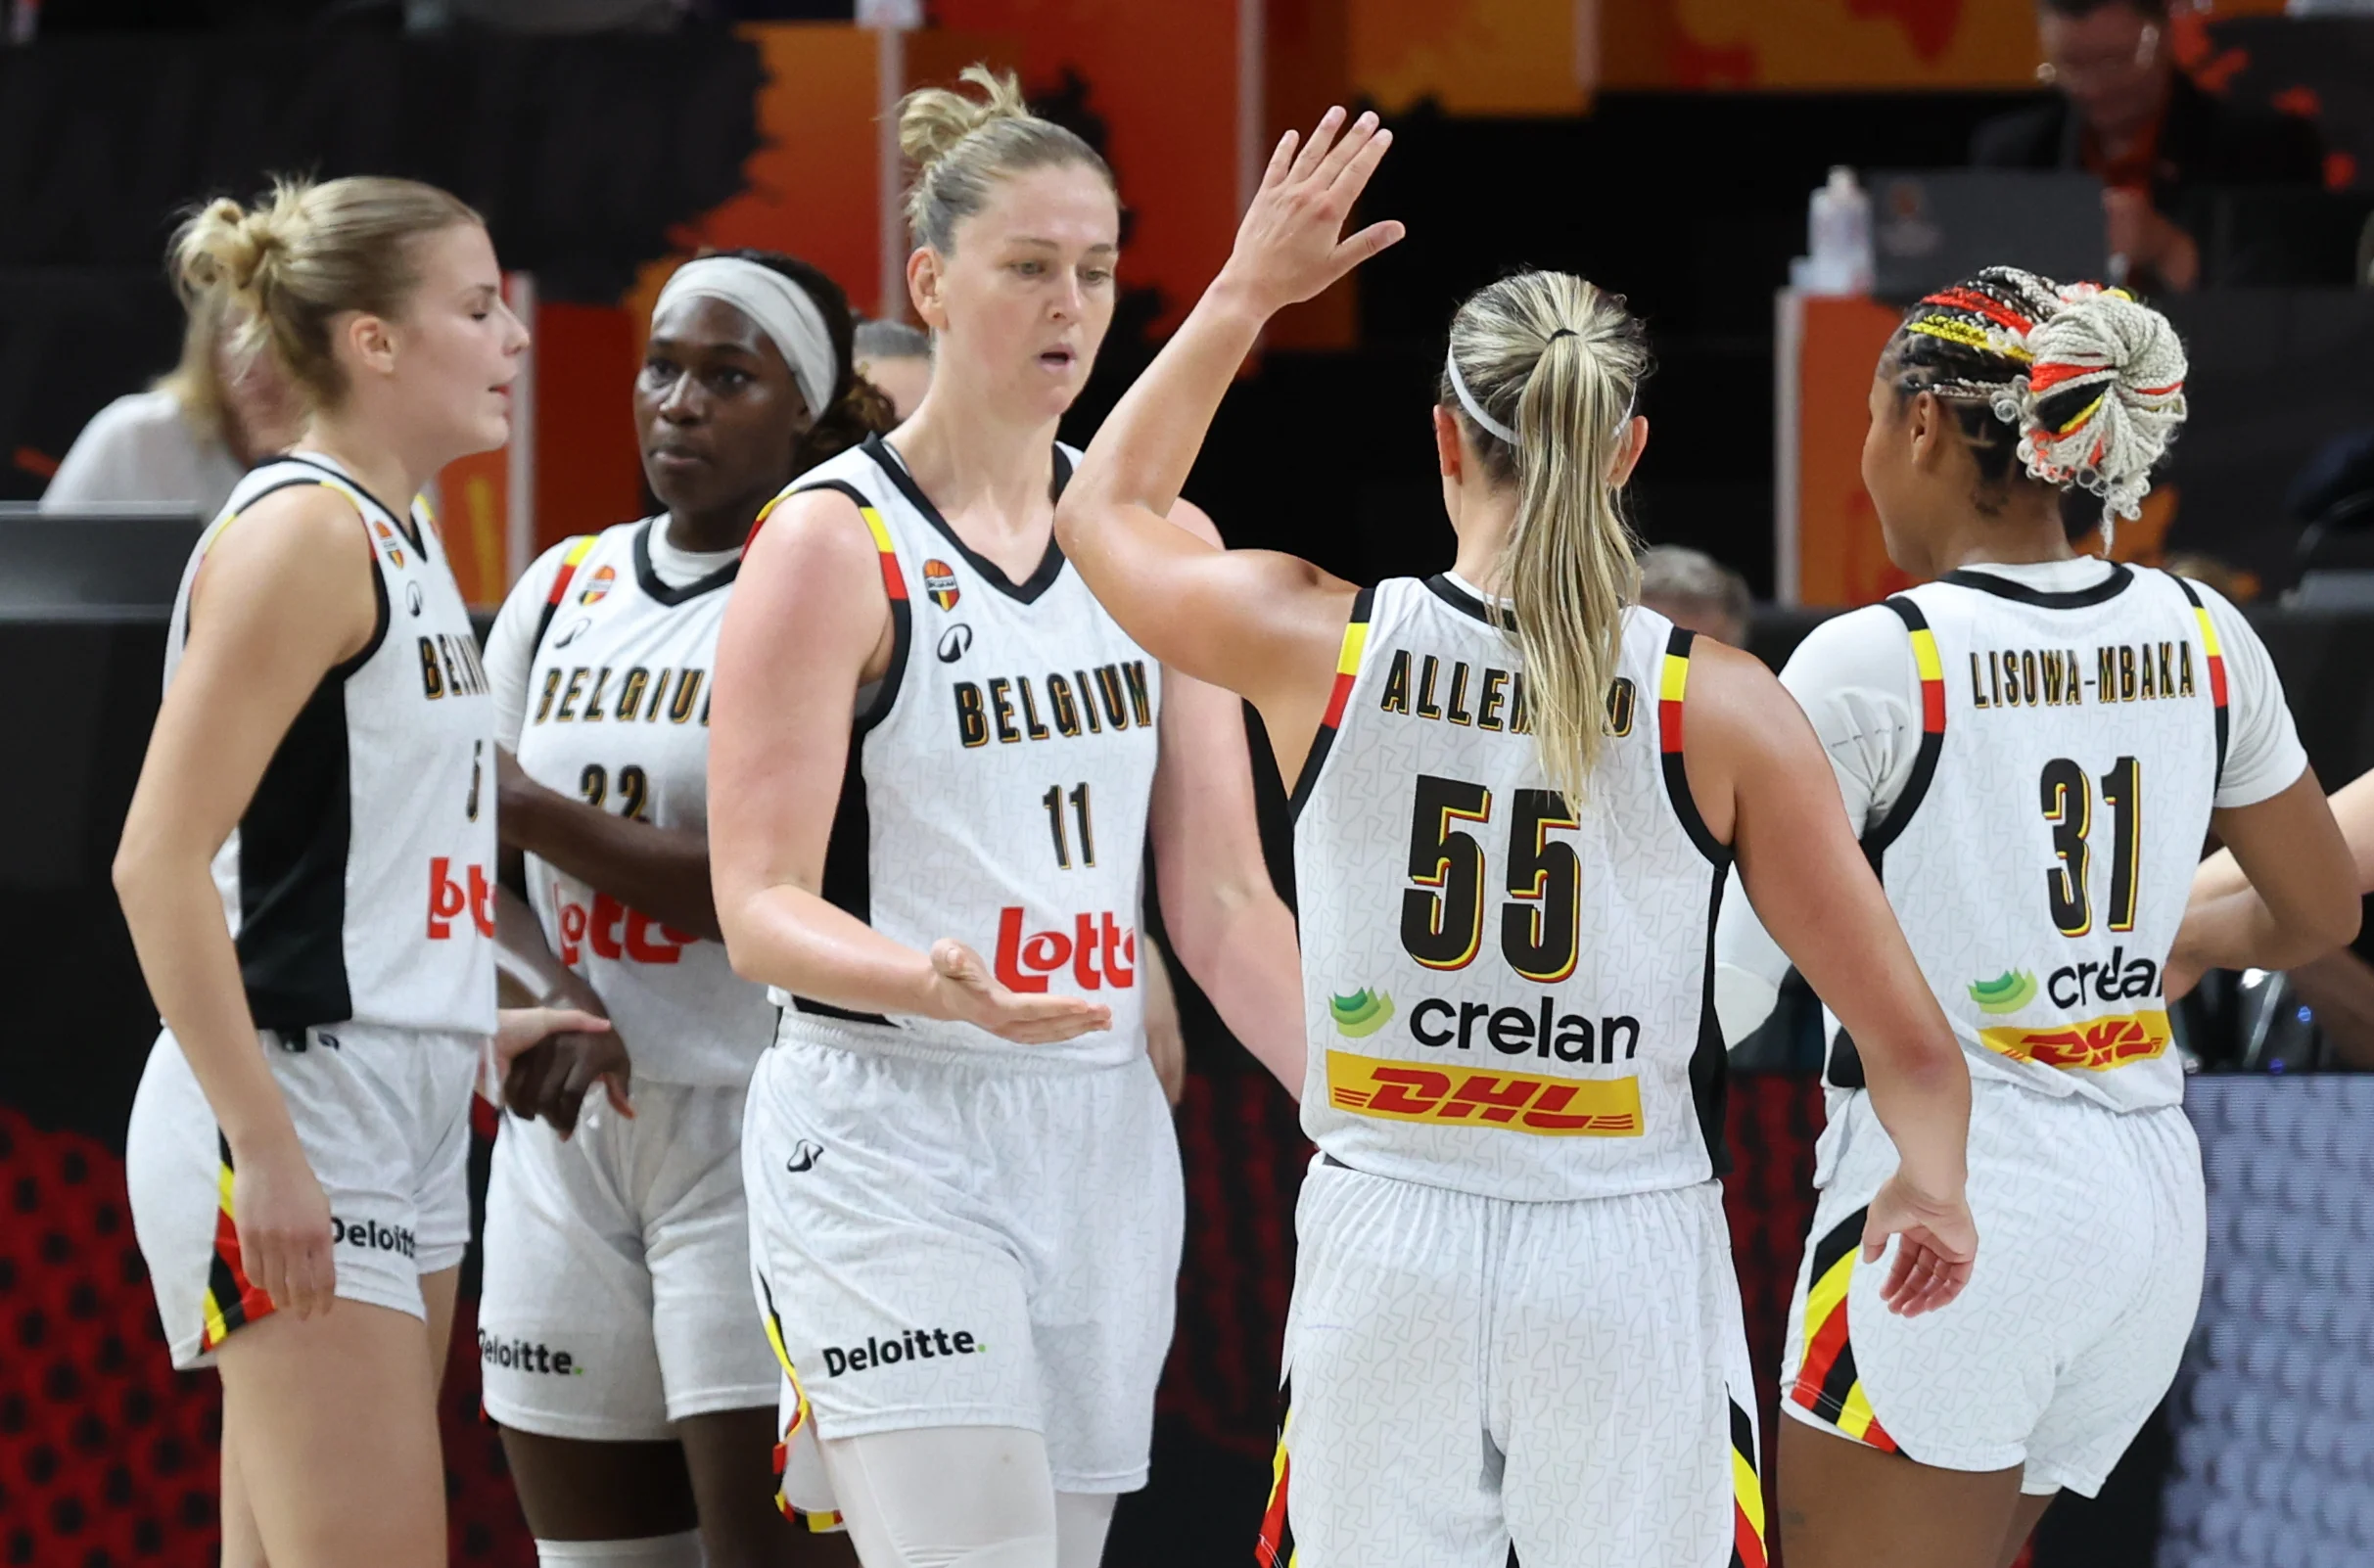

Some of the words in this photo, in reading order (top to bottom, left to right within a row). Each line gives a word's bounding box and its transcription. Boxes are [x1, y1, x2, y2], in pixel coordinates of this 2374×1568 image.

[535, 667, 711, 726] BELGIU
[1970, 640, 2196, 709] LISOWA-MBAKA
[1043, 781, 1096, 870] 11
[2040, 756, 2142, 938] 31
[1401, 774, 1583, 984] 55
[995, 906, 1135, 992] Lott
[1410, 996, 1641, 1064] crelan
[2020, 1020, 2156, 1068] DHL
[1367, 1066, 1594, 1129] DHL
